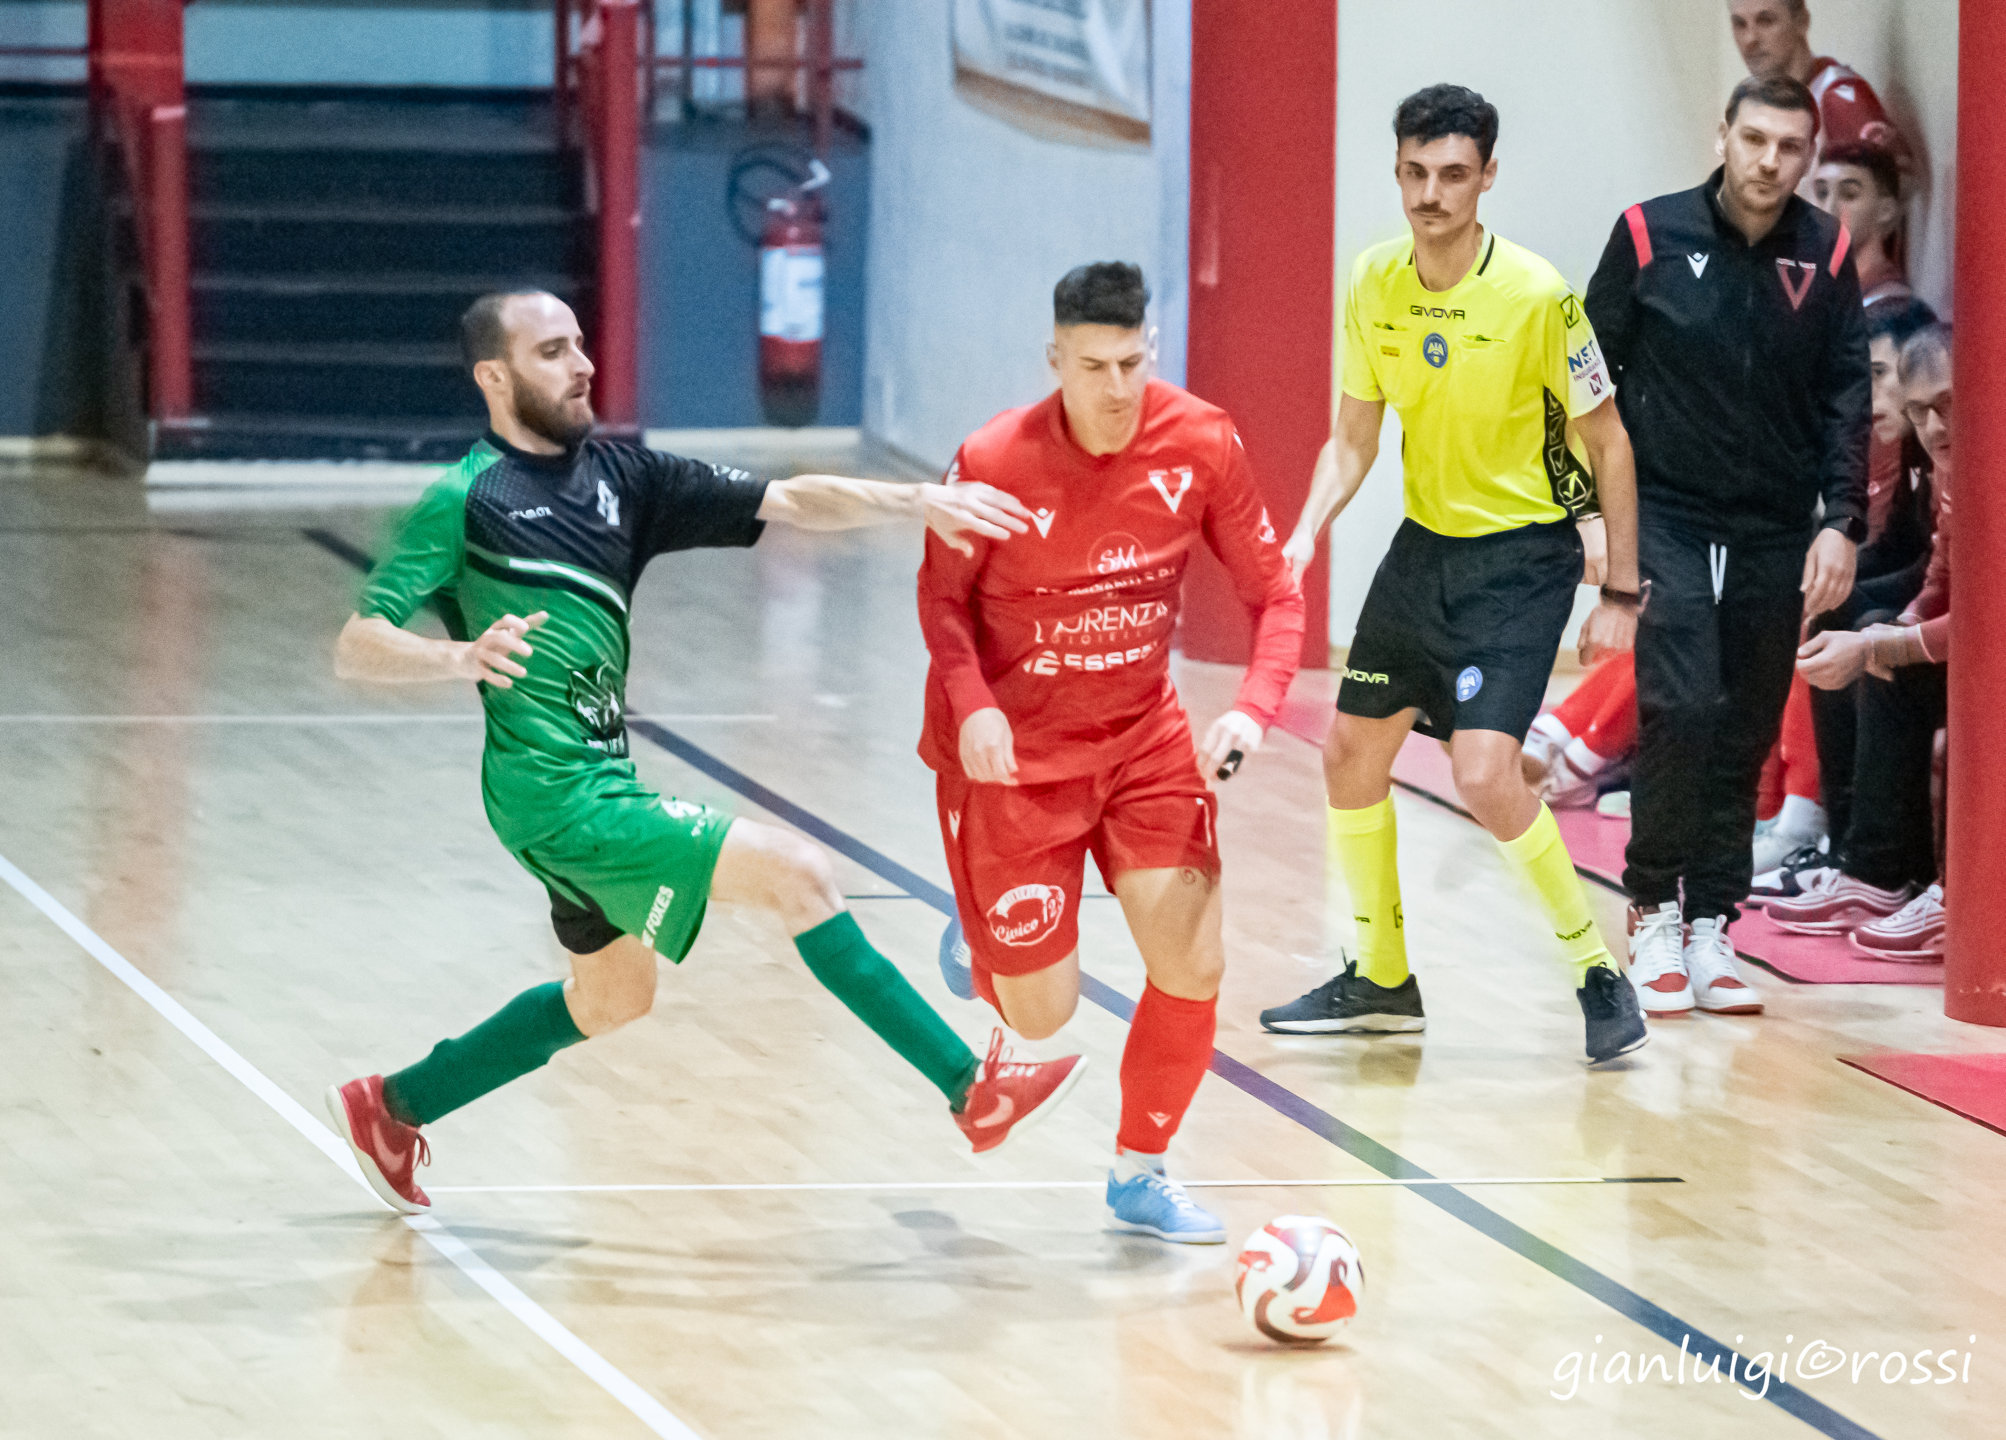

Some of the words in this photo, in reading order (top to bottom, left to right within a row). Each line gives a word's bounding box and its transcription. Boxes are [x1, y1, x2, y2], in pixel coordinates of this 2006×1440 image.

[1410, 304, 1465, 320] GIVOVA
[1097, 544, 1138, 574] SM
[645, 885, 675, 936] FOXES
